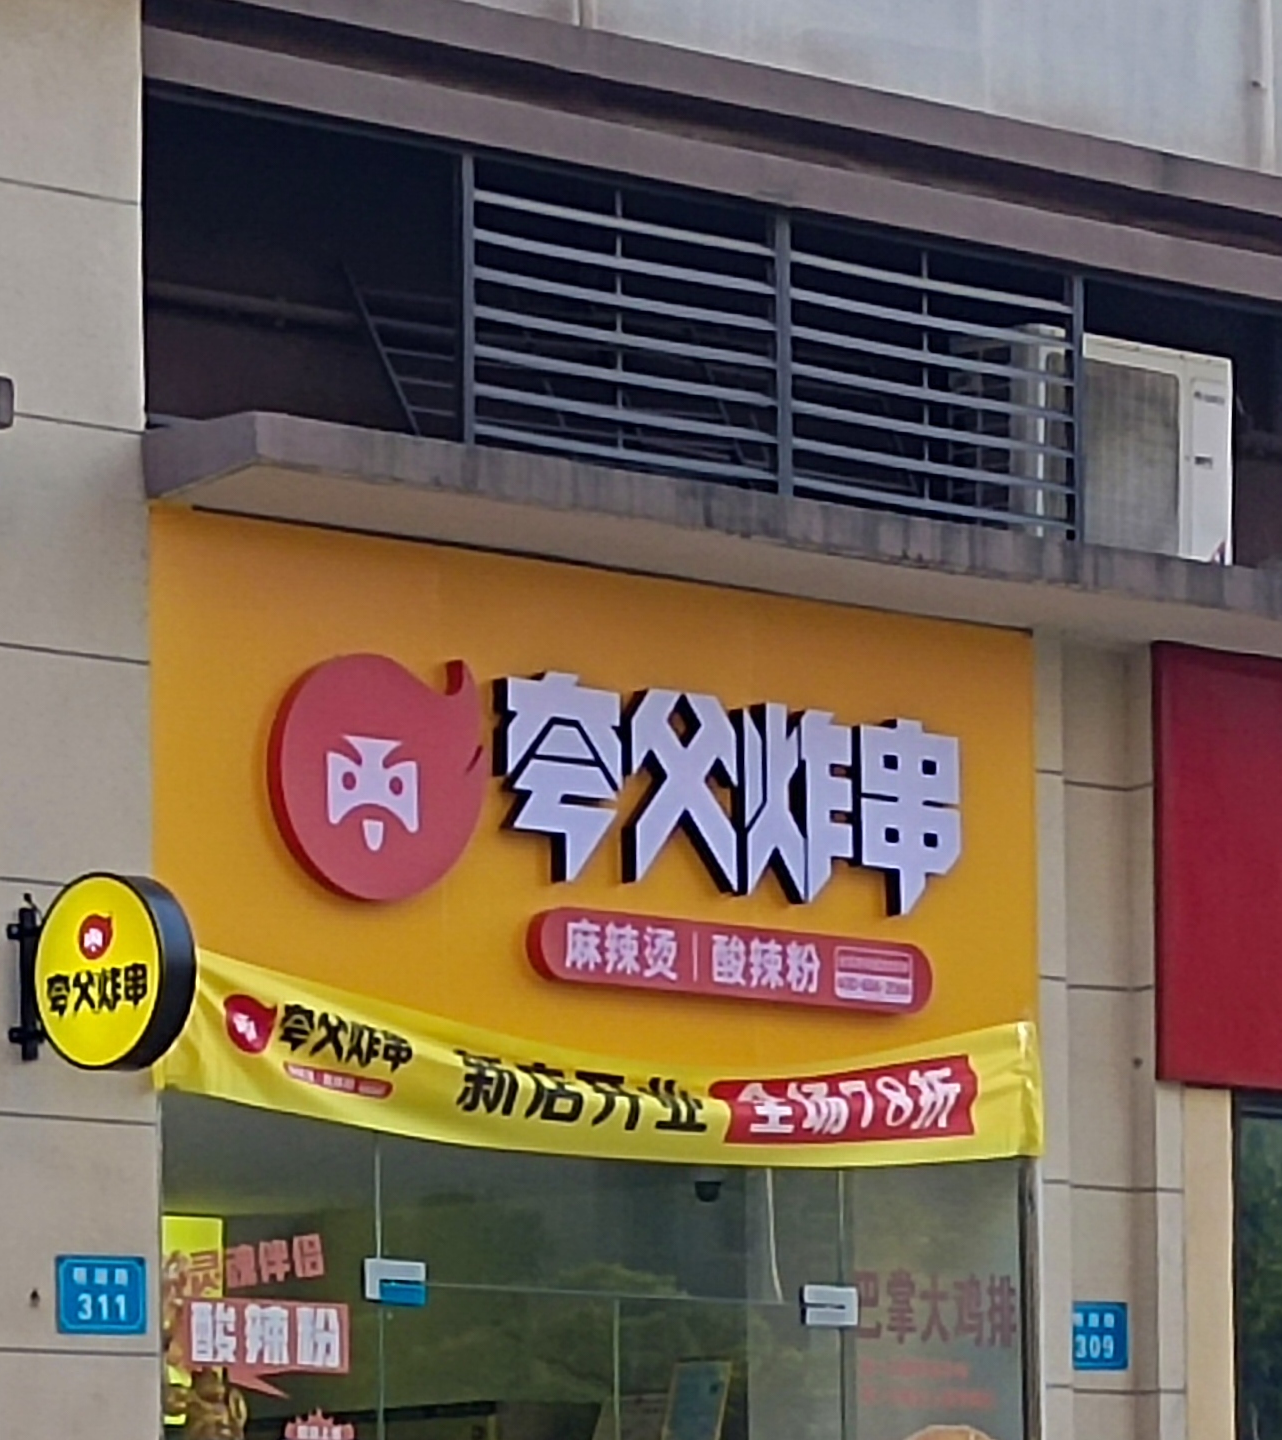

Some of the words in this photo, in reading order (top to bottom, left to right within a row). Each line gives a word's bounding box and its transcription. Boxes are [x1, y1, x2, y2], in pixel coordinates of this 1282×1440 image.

[495, 671, 961, 915] 夸父炸串
[564, 917, 678, 981] 麻辣烫
[710, 933, 821, 994] 酸辣粉
[46, 962, 148, 1018] 夸父炸串
[279, 1003, 413, 1073] 夸父炸串
[456, 1049, 708, 1132] 新店开业
[77, 1292, 127, 1322] 311
[191, 1301, 341, 1368] 酸辣粉
[1075, 1333, 1115, 1359] 309
